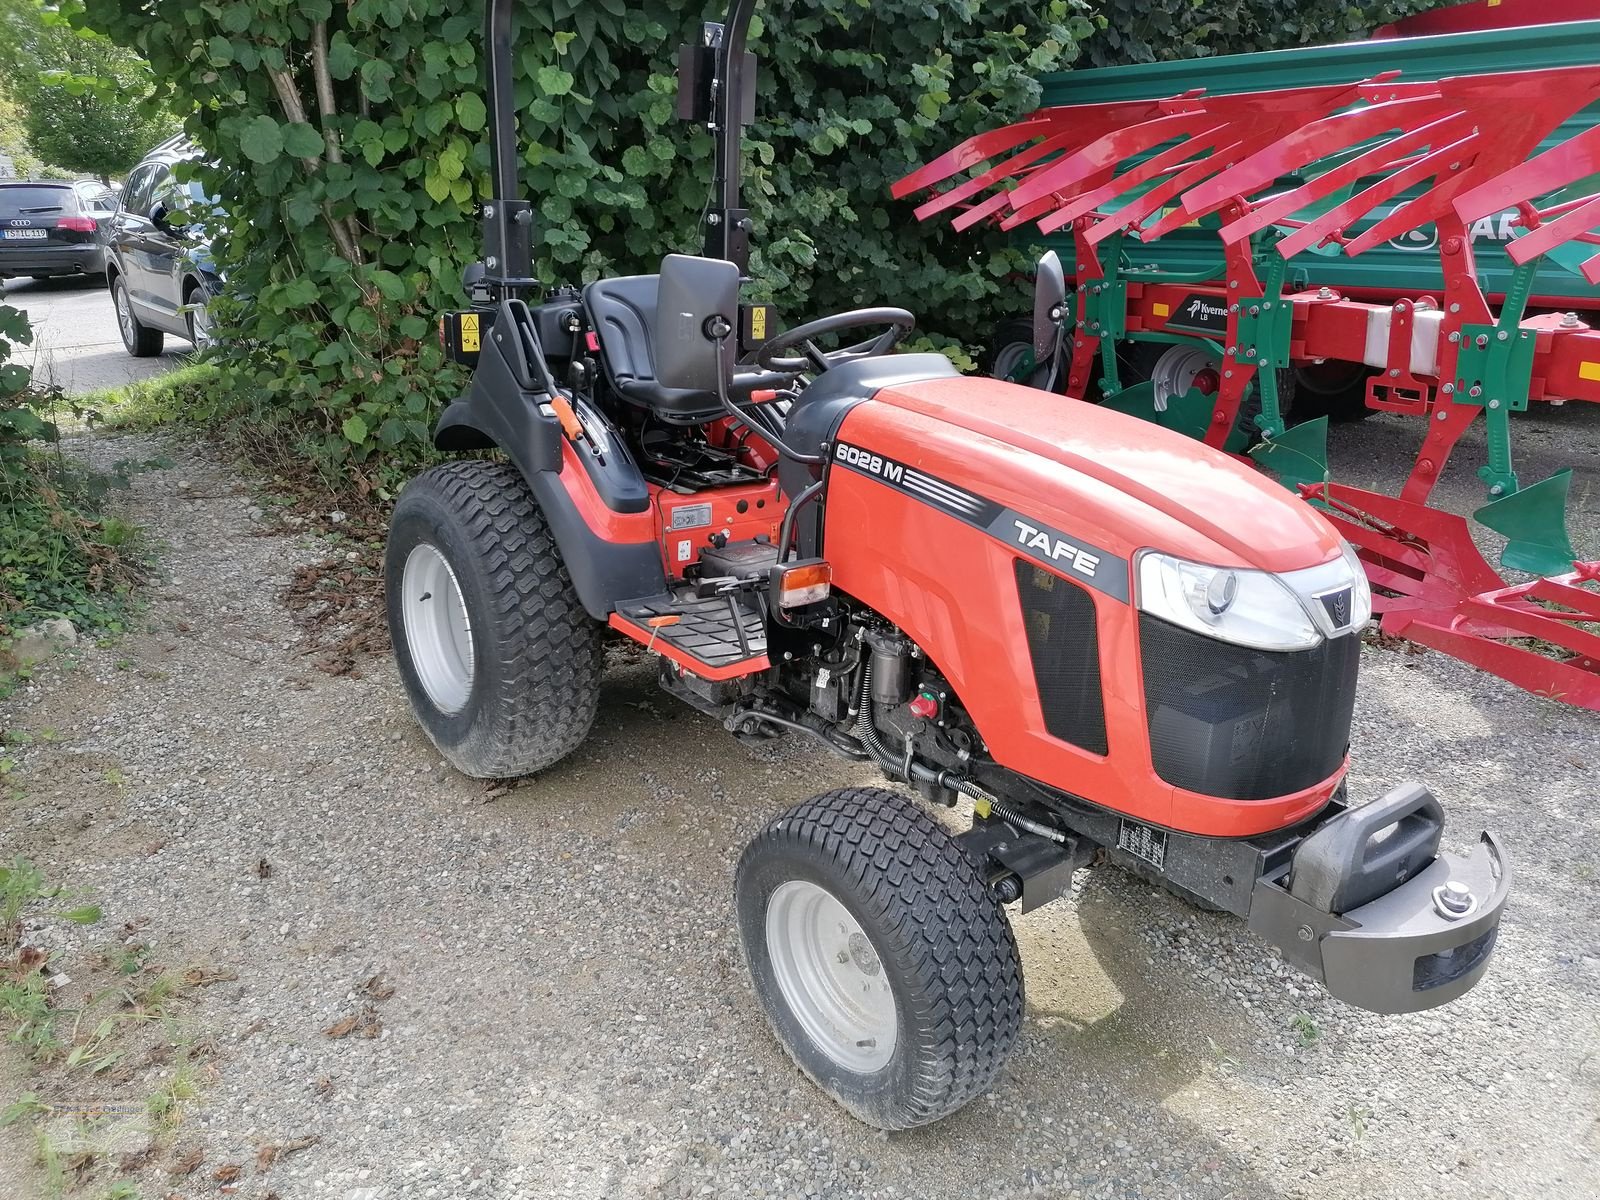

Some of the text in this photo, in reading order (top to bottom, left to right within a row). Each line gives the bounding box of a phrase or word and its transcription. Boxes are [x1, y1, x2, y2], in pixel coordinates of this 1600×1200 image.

[1200, 313, 1209, 321] LB
[836, 443, 904, 483] 6028 M
[1014, 519, 1100, 577] TAFE
